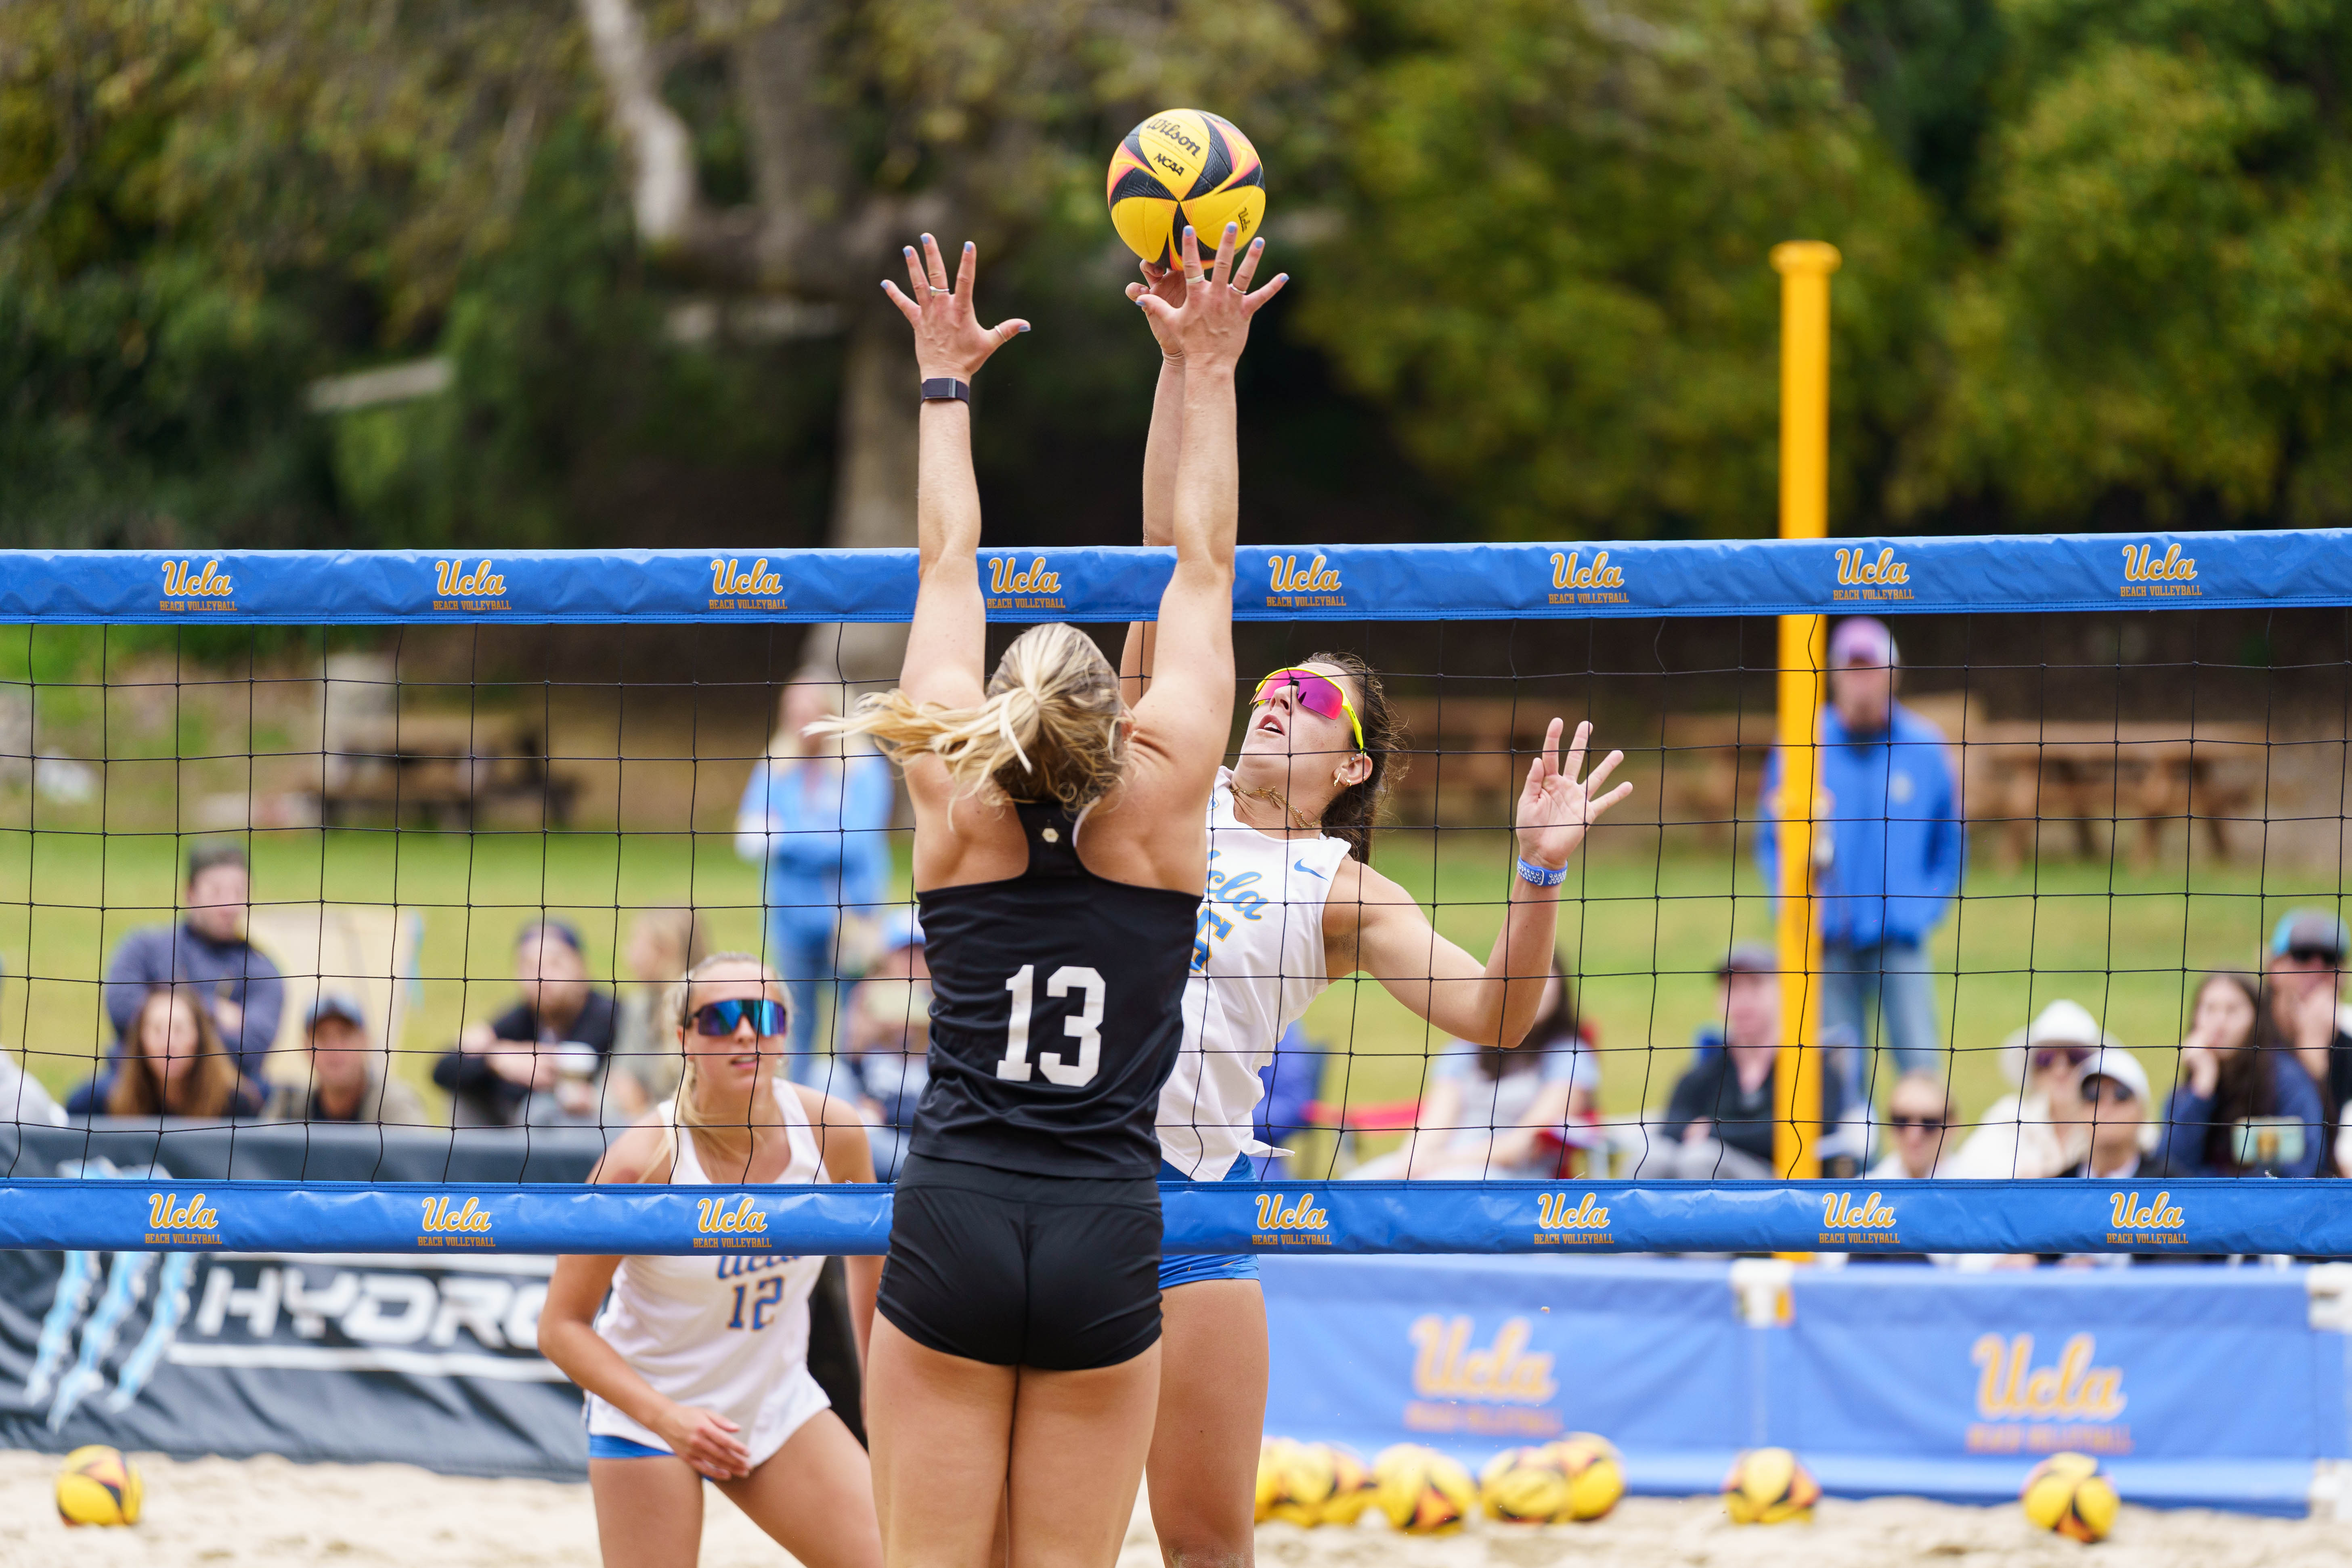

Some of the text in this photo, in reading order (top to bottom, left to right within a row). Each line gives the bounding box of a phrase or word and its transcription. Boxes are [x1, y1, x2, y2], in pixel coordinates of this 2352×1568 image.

[1146, 117, 1201, 158] Wilson
[1153, 153, 1184, 176] NCAA
[161, 559, 233, 597] Ucla
[435, 559, 507, 596] Ucla
[710, 558, 784, 595] Ucla
[988, 556, 1061, 594] Ucla
[1268, 555, 1342, 593] Ucla
[1550, 551, 1625, 590] Ucla
[1834, 547, 1910, 586] Ucla
[2121, 543, 2198, 582] Ucla
[160, 601, 237, 611] BEACH VOLLEYBALL
[433, 601, 511, 610] BEACH VOLLEYBALL
[709, 599, 788, 609] BEACH VOLLEYBALL
[987, 598, 1065, 609] BEACH VOLLEYBALL
[1266, 596, 1346, 607] BEACH VOLLEYBALL
[1549, 593, 1629, 604] BEACH VOLLEYBALL
[1833, 589, 1914, 600] BEACH VOLLEYBALL
[2120, 585, 2202, 597] BEACH VOLLEYBALL
[1203, 849, 1269, 921] cla
[996, 964, 1106, 1087] 13
[148, 1192, 218, 1230] Ucla
[421, 1196, 492, 1233] Ucla
[697, 1197, 768, 1234] Ucla
[1255, 1192, 1329, 1230] Ucla
[1537, 1192, 1610, 1229] Ucla
[1822, 1191, 1896, 1228] Ucla
[2109, 1191, 2184, 1229] Ucla
[145, 1234, 222, 1244] BEACH VOLLEYBALL
[418, 1237, 496, 1247] BEACH VOLLEYBALL
[693, 1238, 772, 1248] BEACH VOLLEYBALL
[1252, 1235, 1331, 1245] BEACH VOLLEYBALL
[1534, 1234, 1614, 1244] BEACH VOLLEYBALL
[1819, 1233, 1900, 1243] BEACH VOLLEYBALL
[2107, 1233, 2188, 1243] BEACH VOLLEYBALL
[726, 1274, 785, 1332] 12
